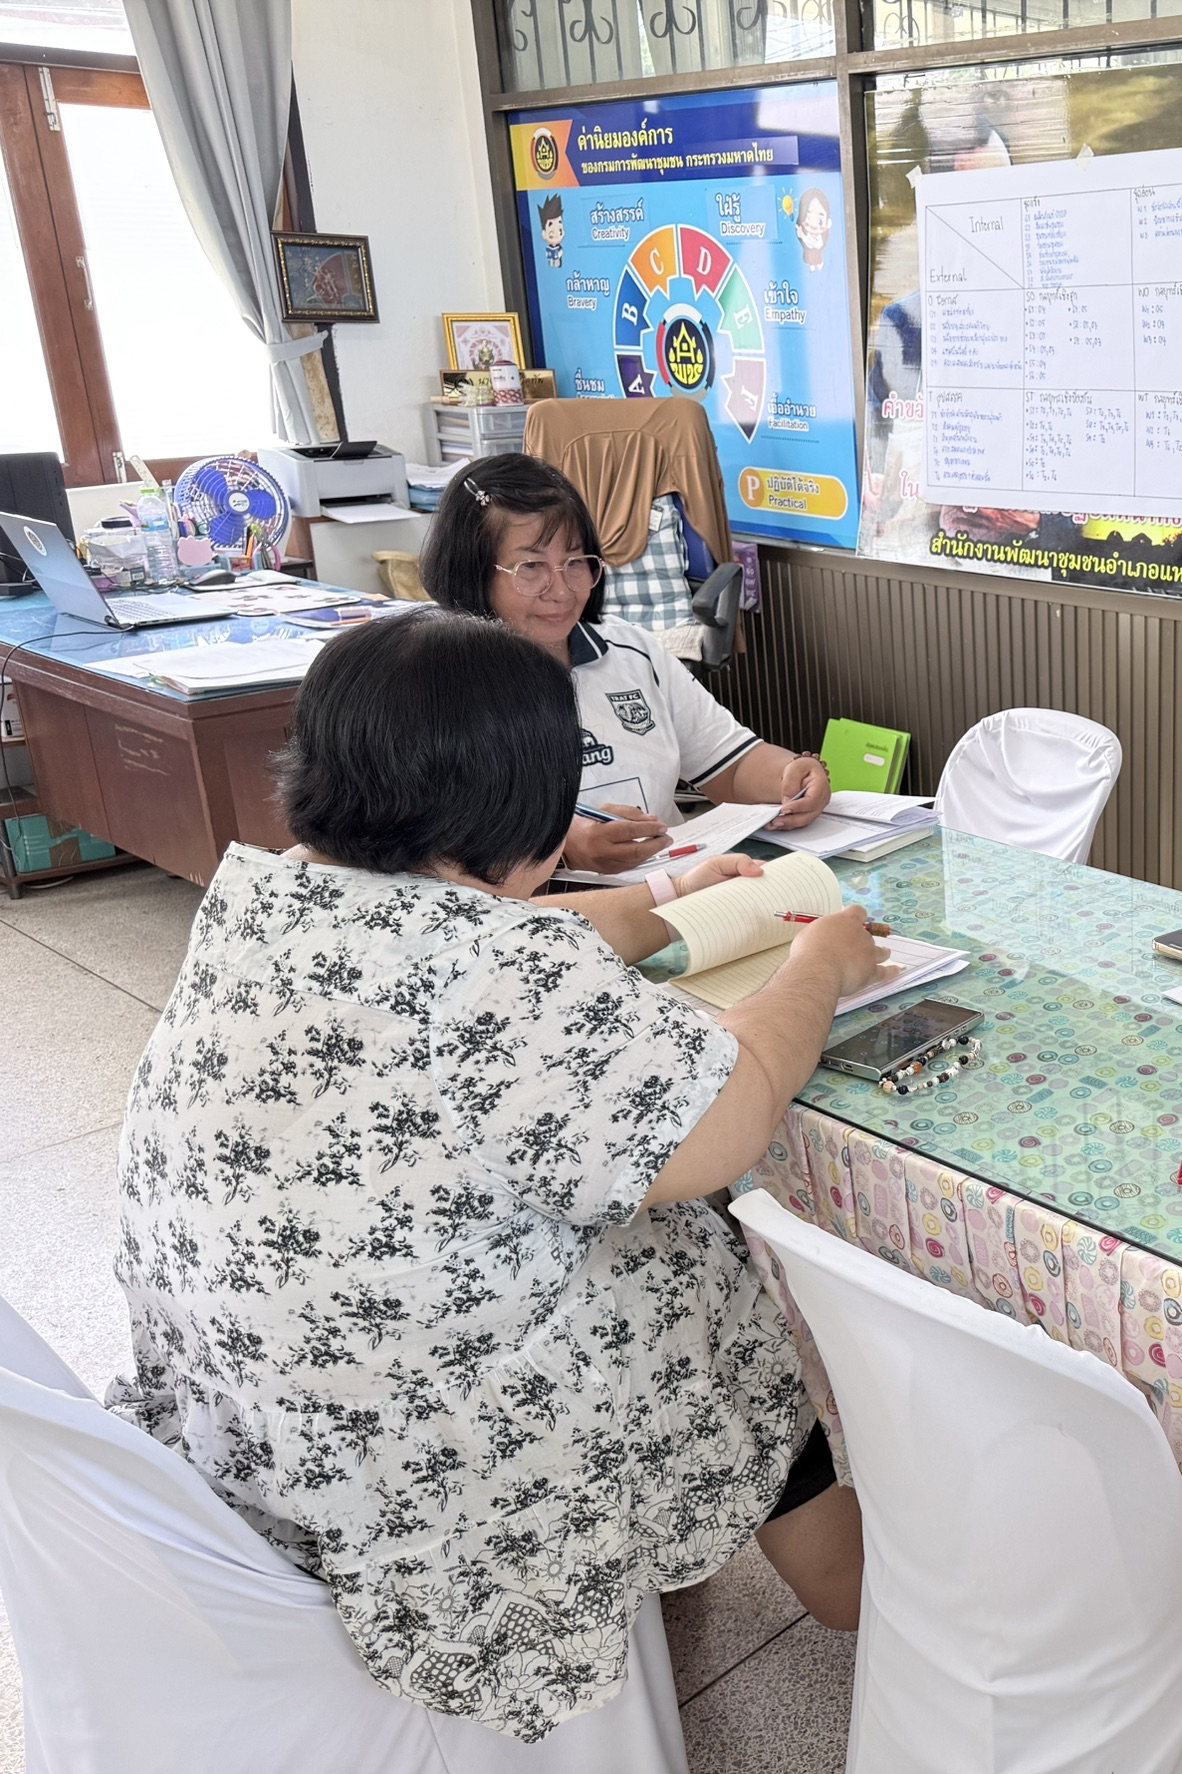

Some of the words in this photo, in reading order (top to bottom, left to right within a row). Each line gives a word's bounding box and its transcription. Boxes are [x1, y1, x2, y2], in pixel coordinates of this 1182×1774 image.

[577, 118, 673, 151] ค่านิยมองค์การ
[581, 153, 684, 176] ของกรมการพัฒนาชุมชน
[686, 142, 774, 168] กระทรวงมหาดไทย
[590, 197, 644, 225] สร้างสรรค์
[715, 193, 741, 222] ใฝ่รู้
[592, 228, 630, 240] Creativity
[721, 222, 765, 237] Discovery
[969, 215, 1004, 233] Internal
[697, 246, 712, 275] D
[566, 271, 610, 300] กล้าหาญ
[929, 265, 968, 283] External
[568, 297, 597, 310] Bravery
[764, 280, 799, 305] เข้าใจ
[766, 309, 806, 323] Empathy
[575, 367, 605, 393] ชื่นชม
[745, 475, 760, 500] P
[769, 494, 806, 509] Practical
